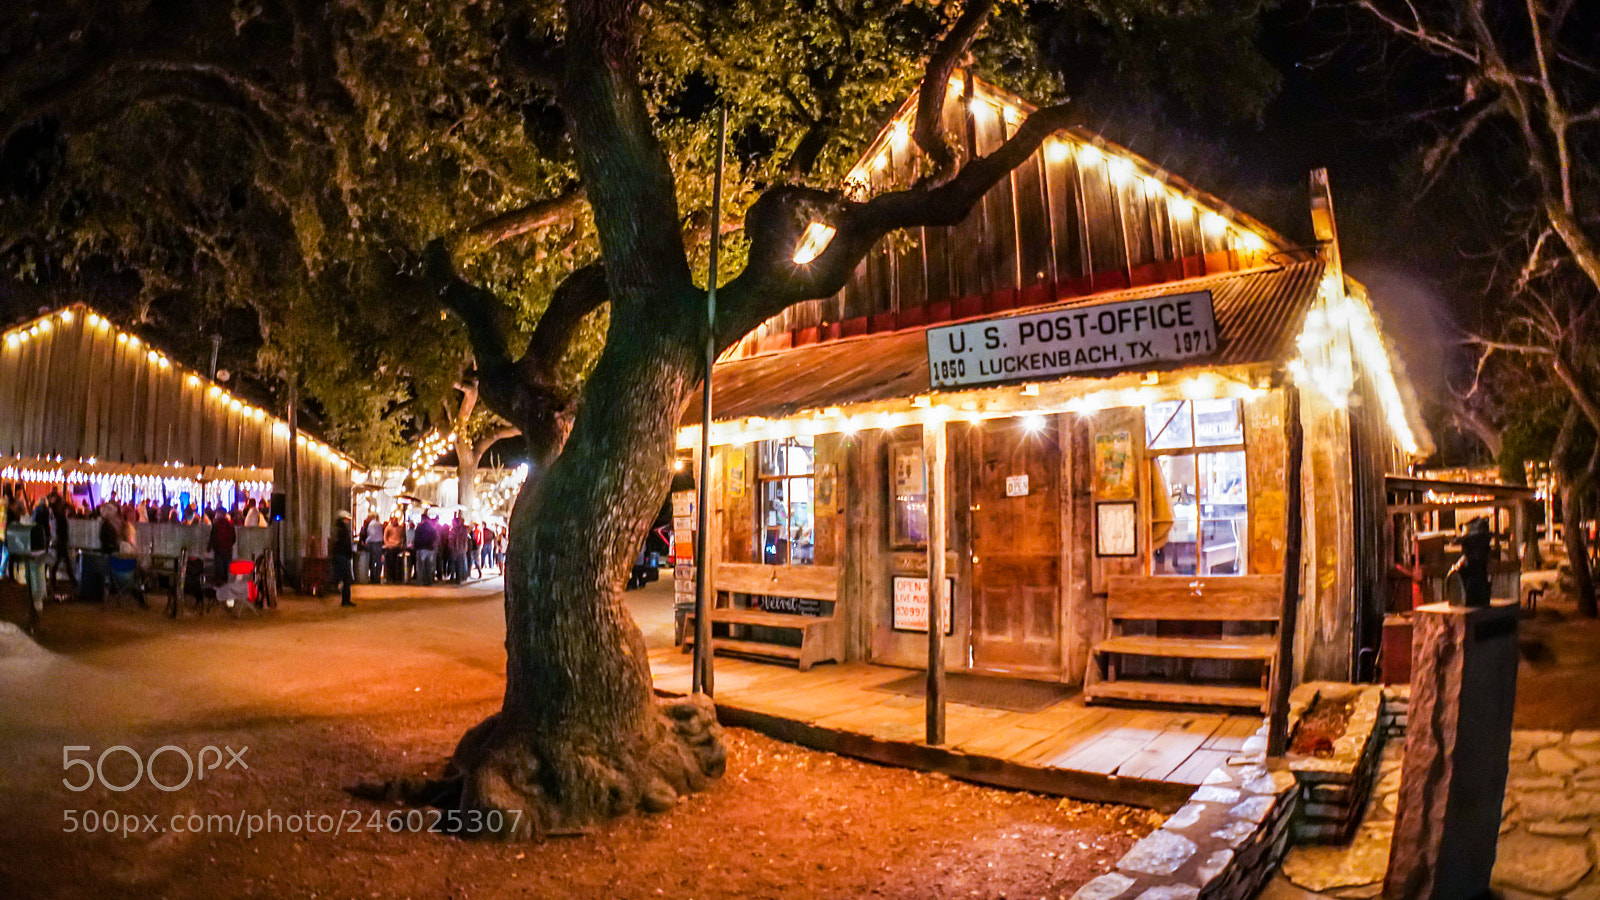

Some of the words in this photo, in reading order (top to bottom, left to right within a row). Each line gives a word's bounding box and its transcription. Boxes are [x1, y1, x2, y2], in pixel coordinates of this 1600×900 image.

[948, 329, 974, 354] U.
[984, 326, 1007, 350] S.
[1019, 301, 1194, 346] POST-OFFICE
[933, 359, 966, 381] 1850
[1174, 329, 1212, 354] 1971
[897, 580, 921, 591] OPEN
